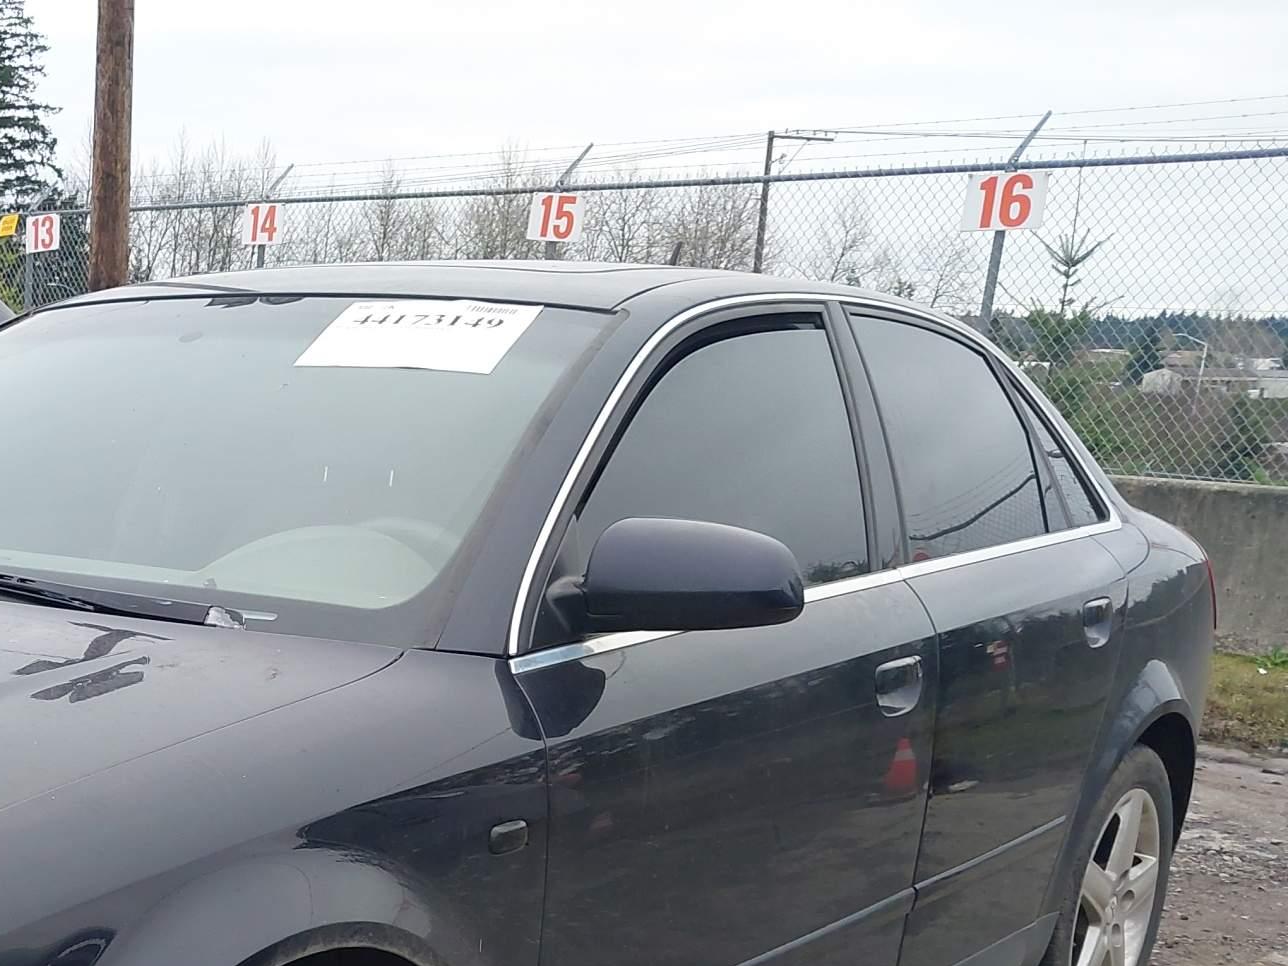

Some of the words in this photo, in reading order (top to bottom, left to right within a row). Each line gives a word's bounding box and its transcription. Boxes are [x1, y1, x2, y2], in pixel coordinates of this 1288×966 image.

[539, 194, 577, 239] 15
[978, 173, 1033, 228] 16
[32, 216, 54, 250] 13
[250, 205, 277, 241] 14
[353, 313, 505, 329] 44173149
